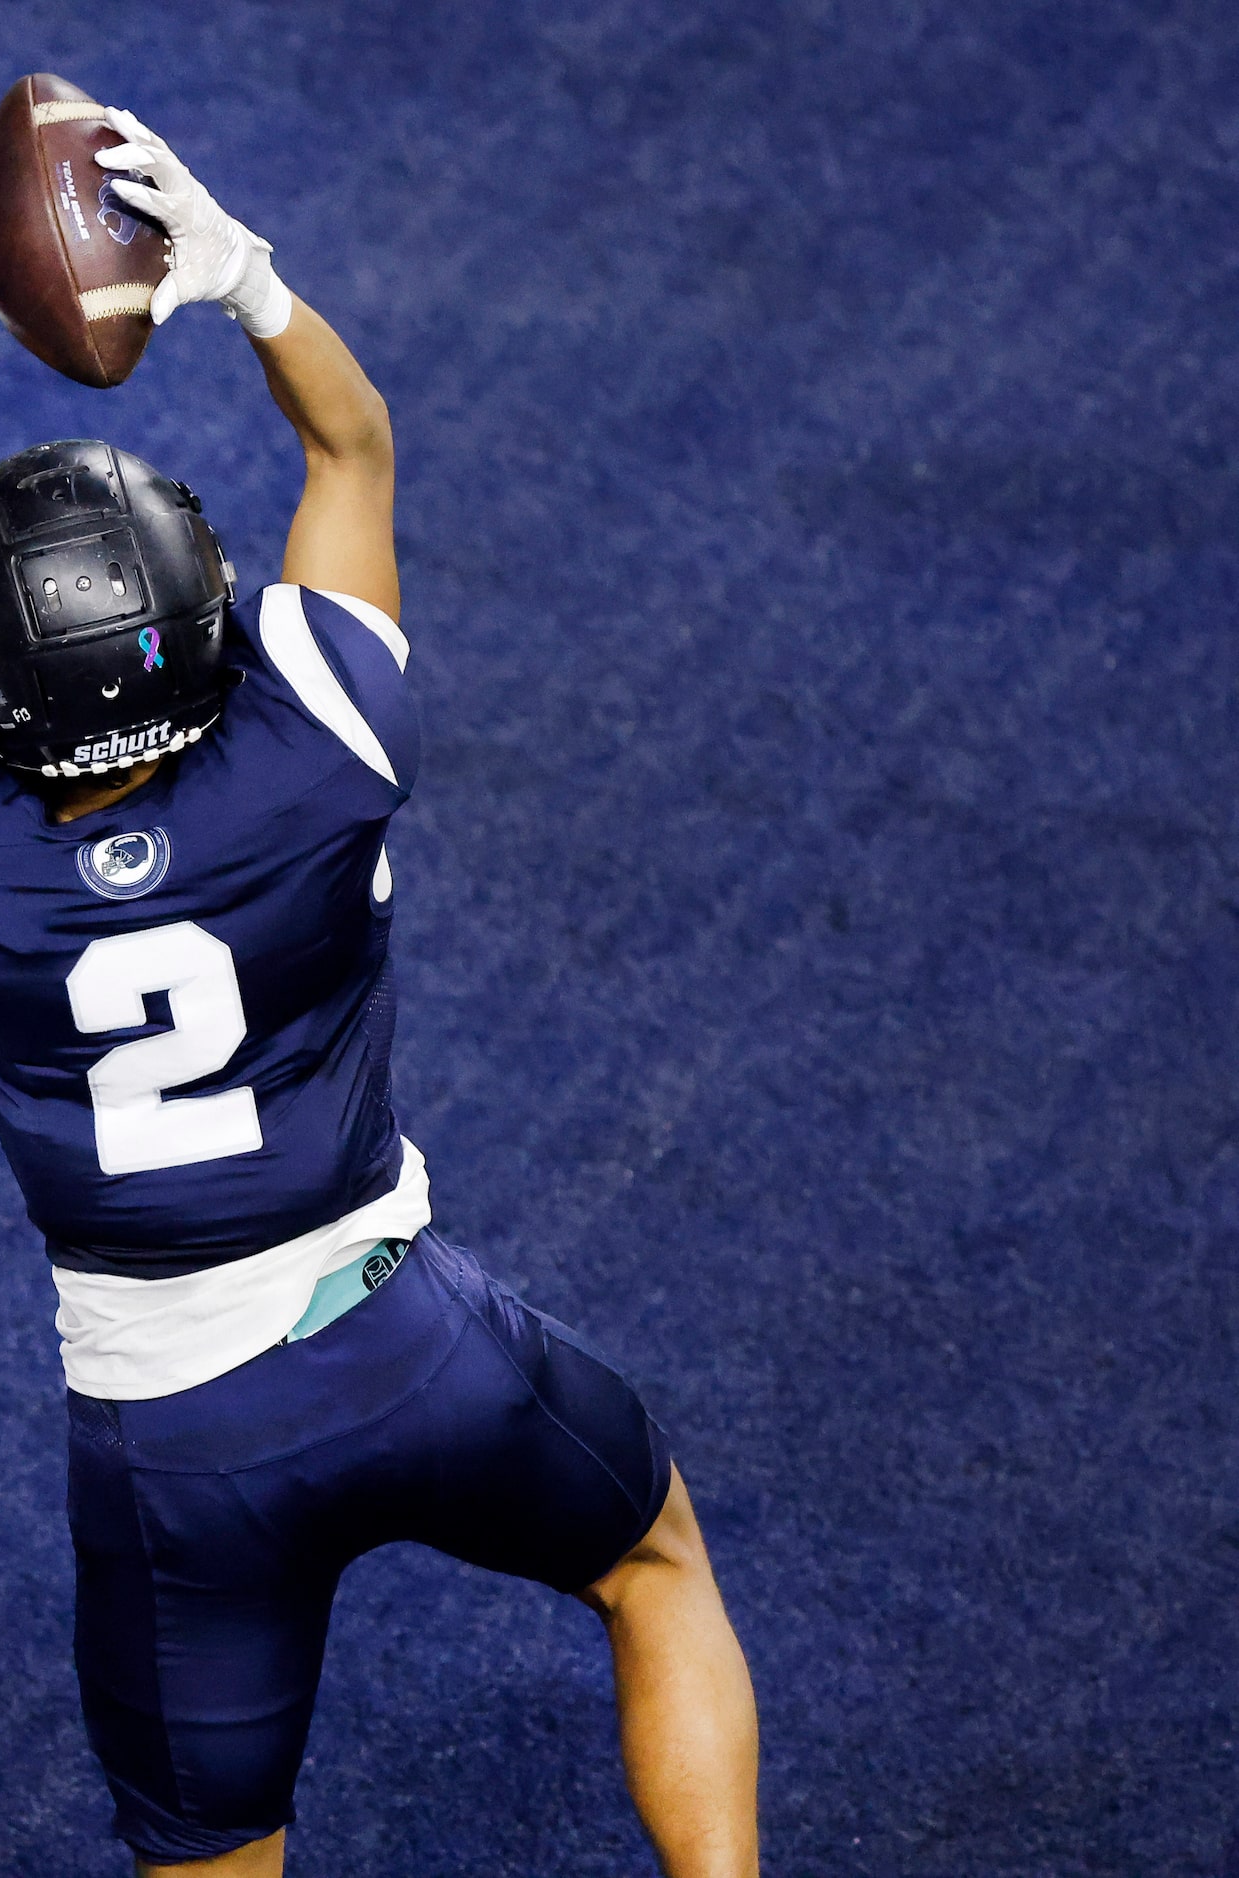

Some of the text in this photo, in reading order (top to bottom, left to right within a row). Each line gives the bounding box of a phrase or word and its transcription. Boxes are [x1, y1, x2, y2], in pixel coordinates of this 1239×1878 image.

[62, 160, 76, 197] TEAM
[73, 719, 171, 763] schutt
[66, 920, 263, 1176] 2
